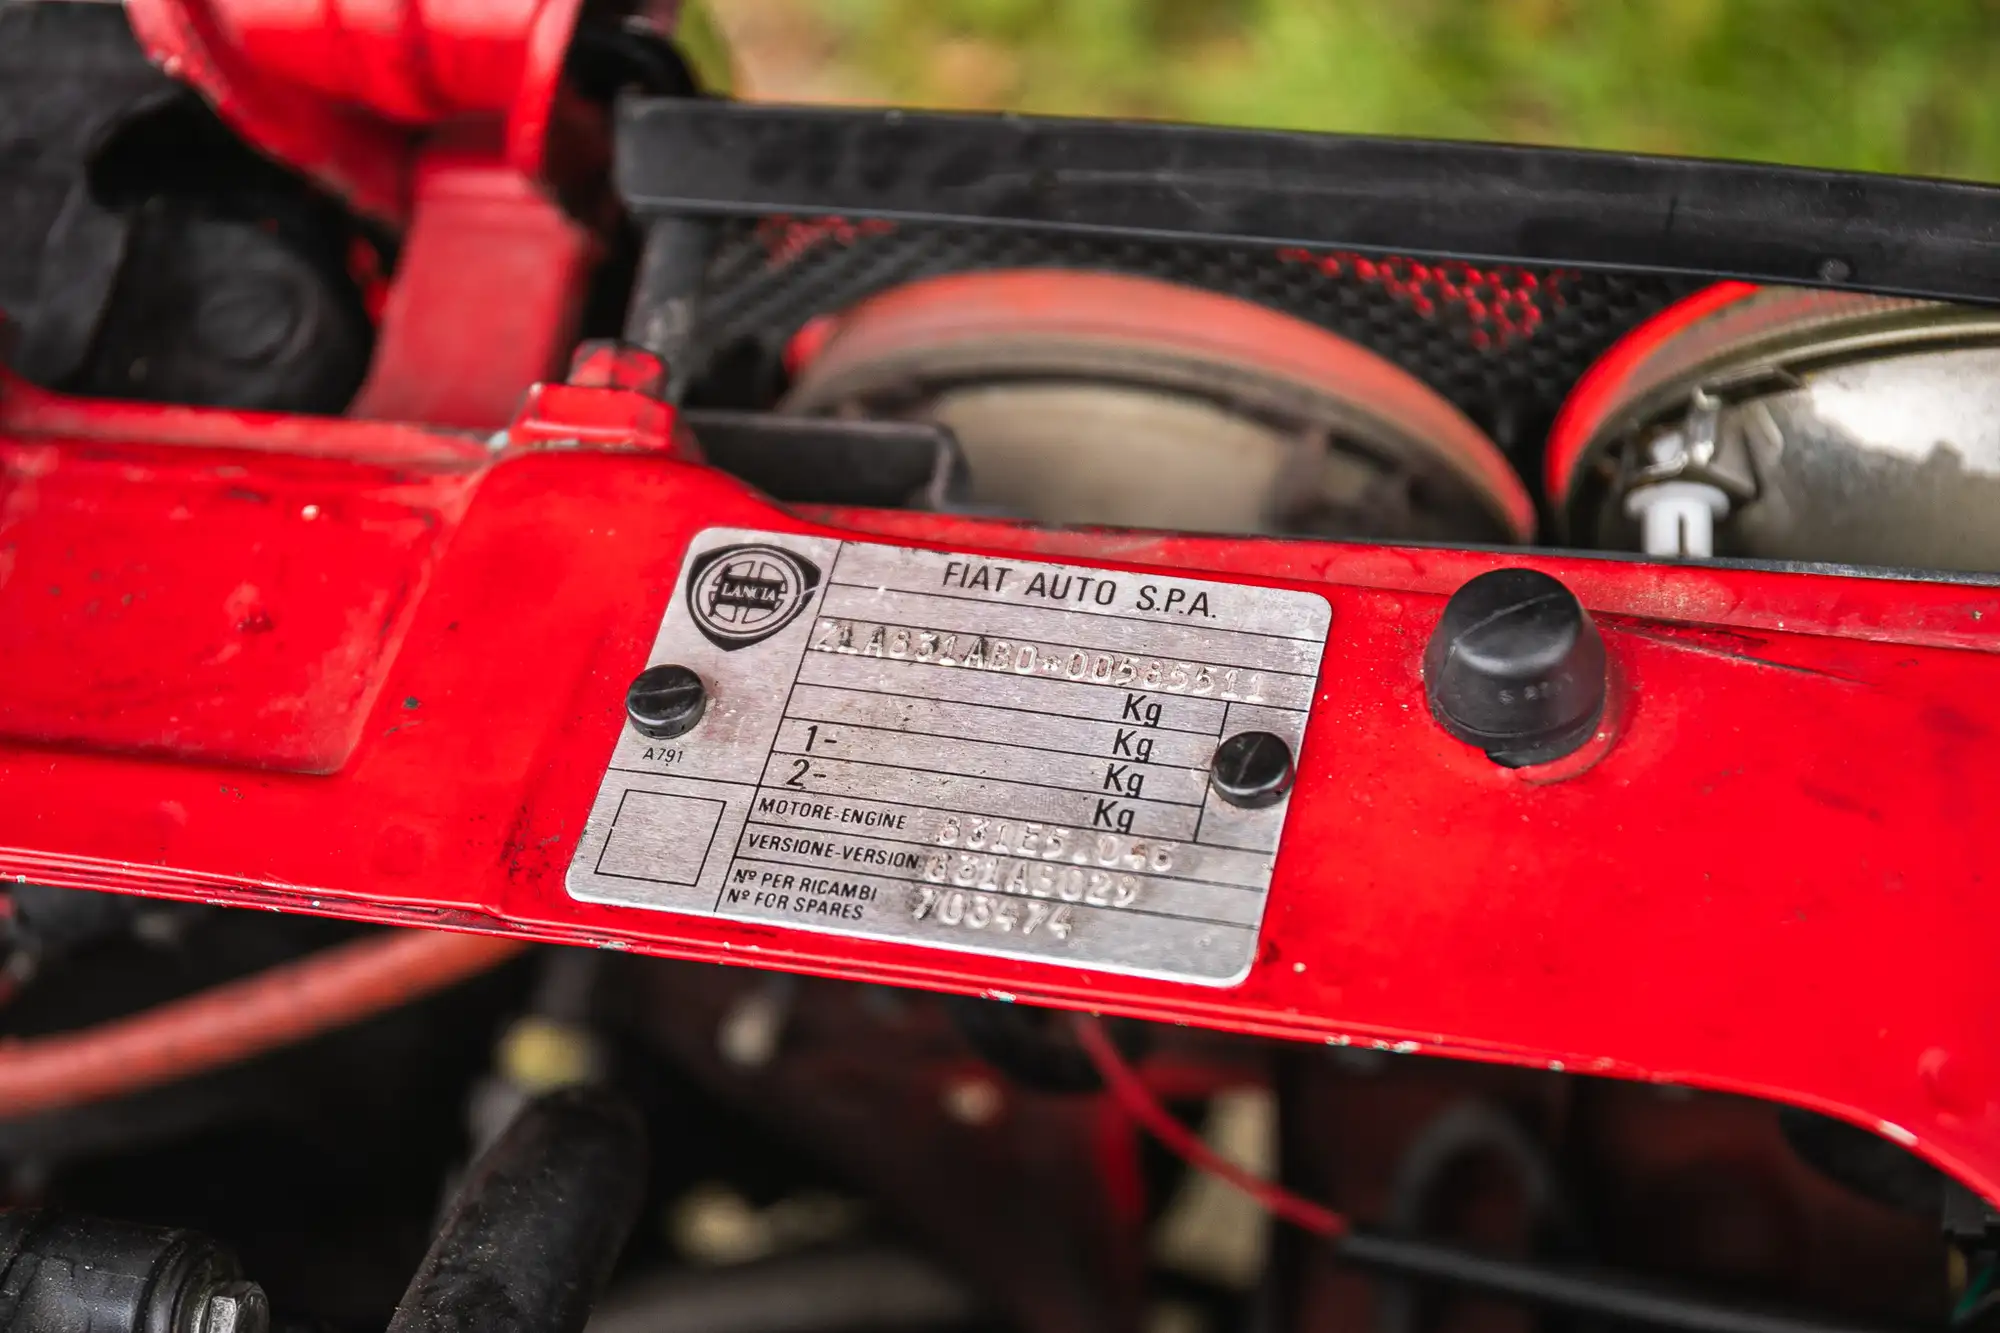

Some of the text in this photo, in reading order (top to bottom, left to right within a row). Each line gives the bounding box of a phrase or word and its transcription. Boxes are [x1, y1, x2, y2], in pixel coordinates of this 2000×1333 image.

[722, 582, 779, 601] LANCIA
[942, 562, 1217, 618] FIAT AUTO S.P.A.
[1122, 693, 1162, 727] Kg
[643, 747, 684, 764] A791
[1112, 728, 1153, 763] Kg
[1103, 763, 1144, 798] Kg
[758, 798, 907, 830] MOTORE-ENGINE
[1093, 799, 1135, 833] Kg
[749, 833, 919, 869] VERSIONE-VERSION
[761, 872, 795, 890] PER
[799, 877, 878, 901] RICAMBI
[754, 891, 789, 910] FOR
[793, 897, 864, 921] SPARES
